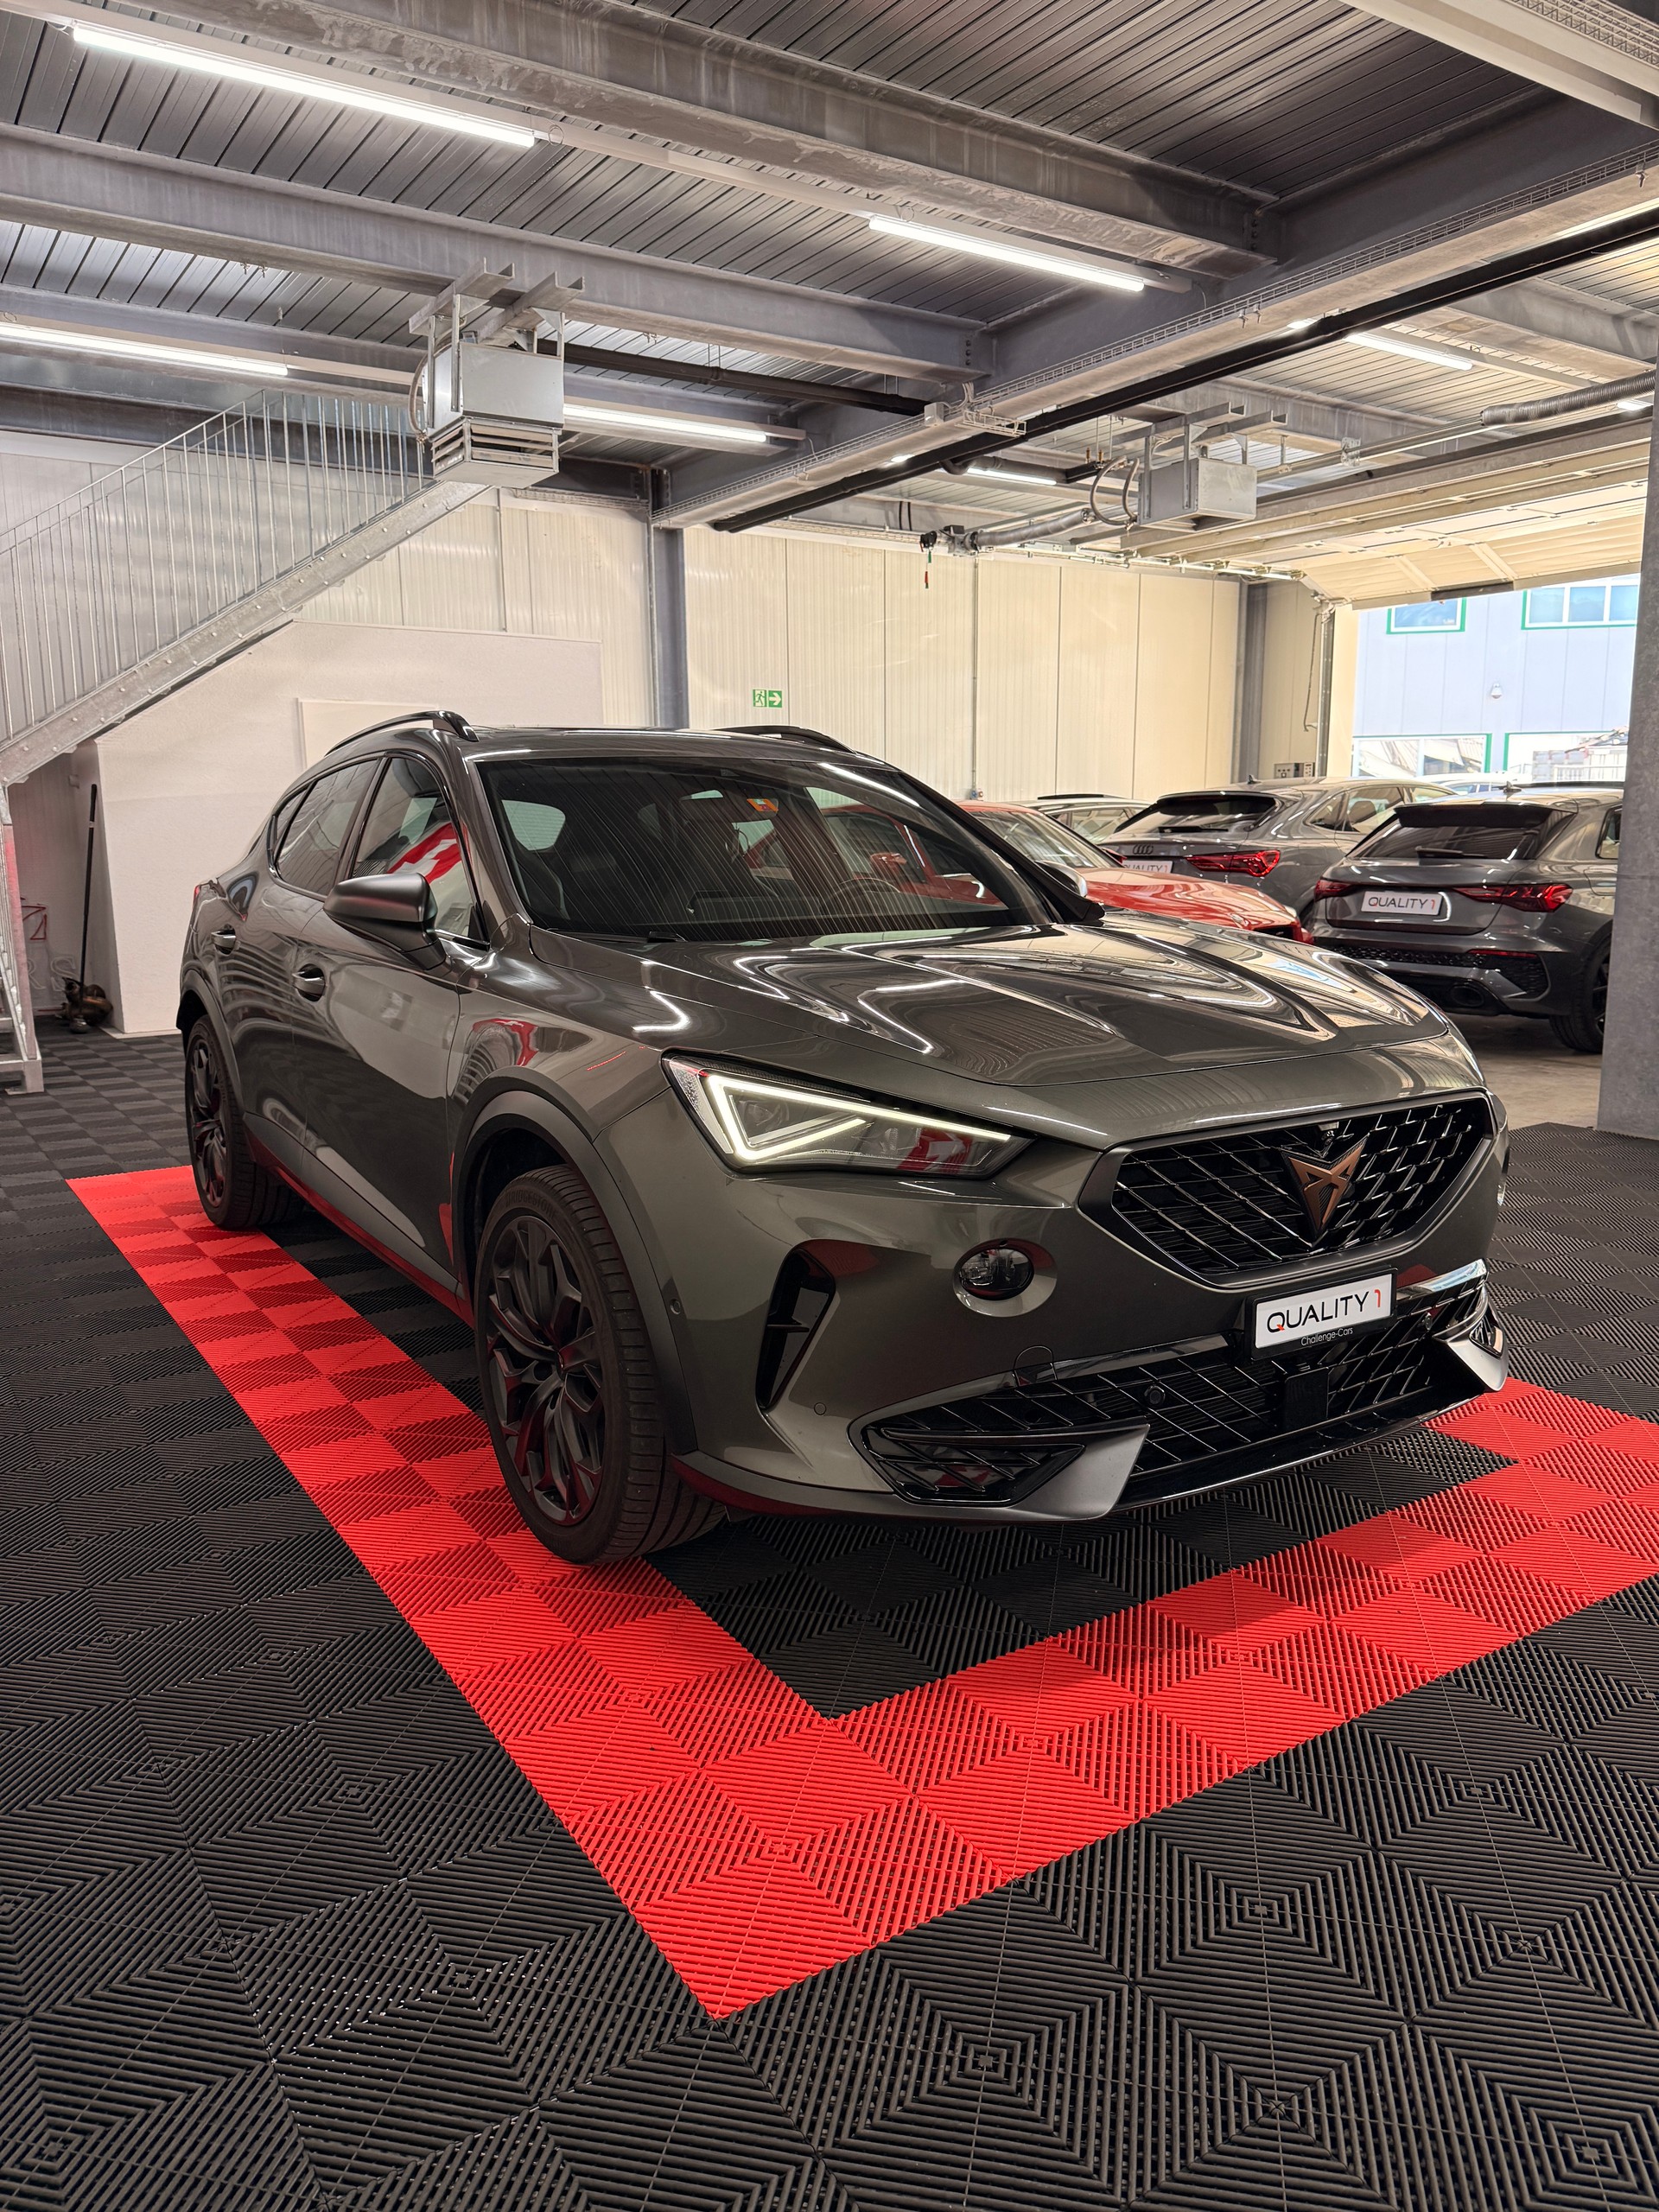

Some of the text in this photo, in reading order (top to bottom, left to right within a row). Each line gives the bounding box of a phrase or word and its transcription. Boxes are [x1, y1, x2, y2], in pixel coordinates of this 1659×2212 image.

[1368, 897, 1436, 910] QUALITY 1
[1267, 1288, 1382, 1333] QUALITY 1
[1300, 1326, 1354, 1347] Challenge-Cars
